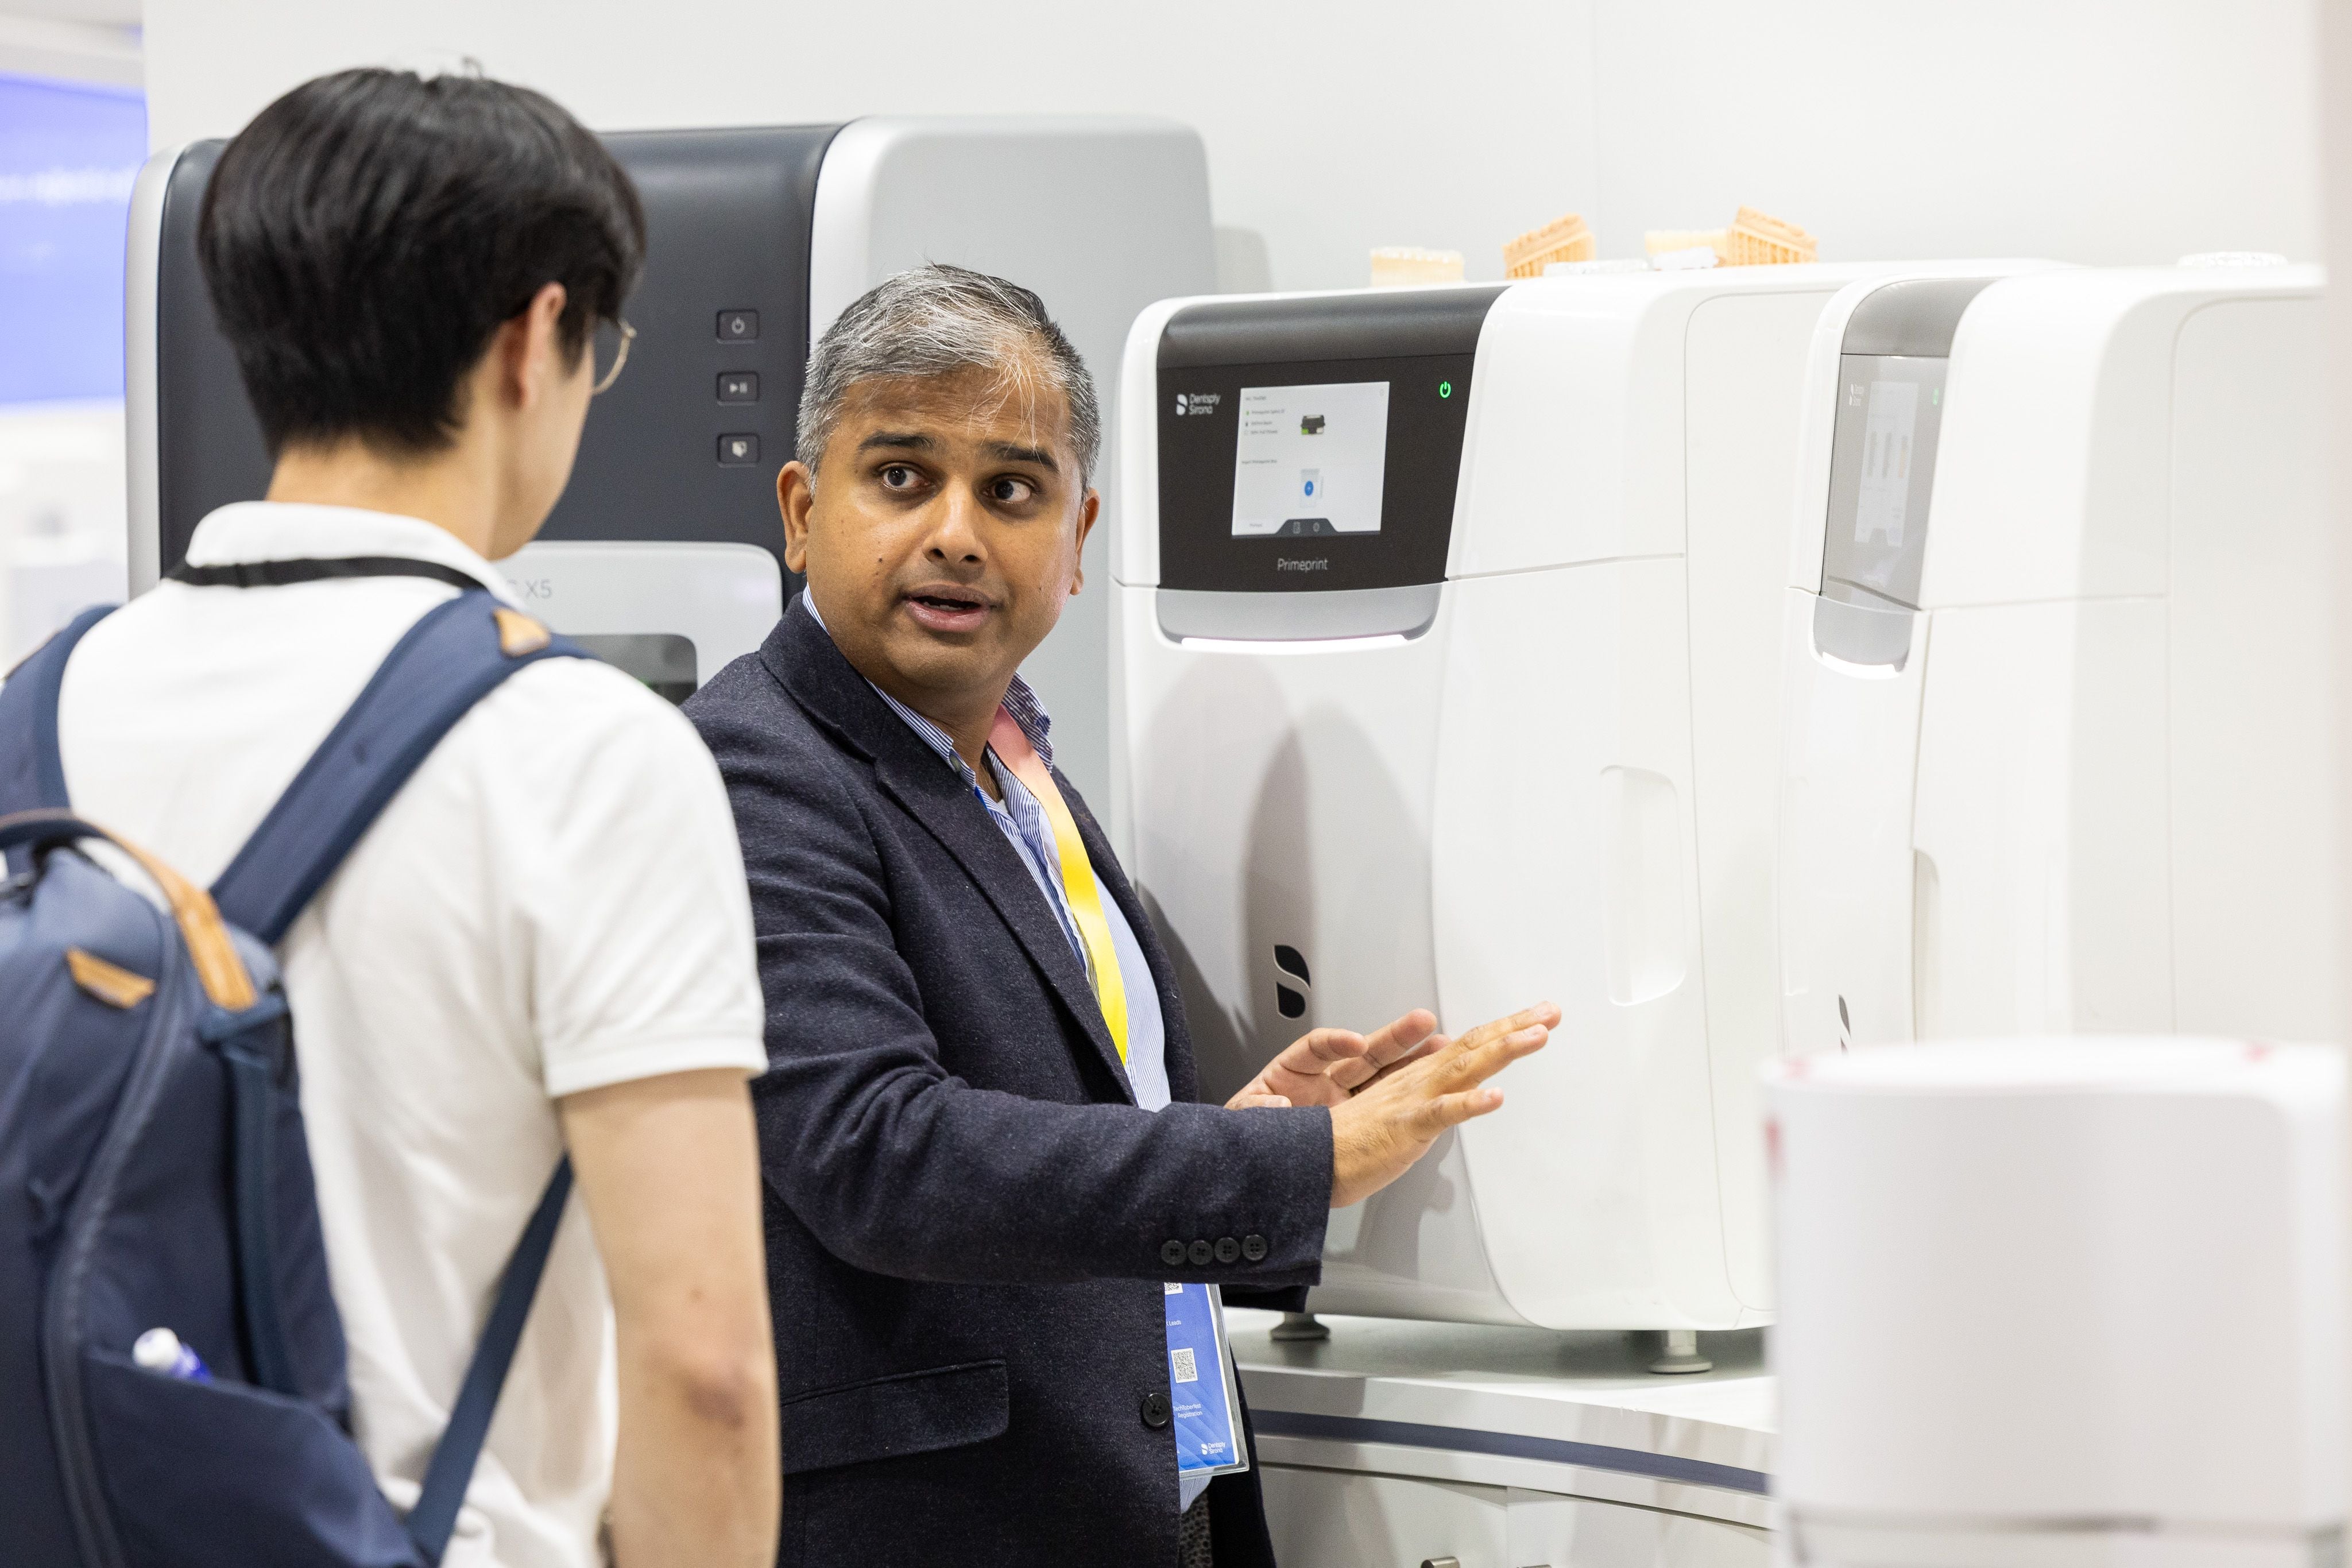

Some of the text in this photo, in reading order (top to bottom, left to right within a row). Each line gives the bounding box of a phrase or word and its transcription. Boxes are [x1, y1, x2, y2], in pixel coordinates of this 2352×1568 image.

[1189, 404, 1213, 416] Sirona
[1277, 557, 1328, 574] Primeprint
[525, 578, 552, 599] X5
[1178, 1411, 1203, 1419] Registration
[1208, 1441, 1226, 1449] Dentsply
